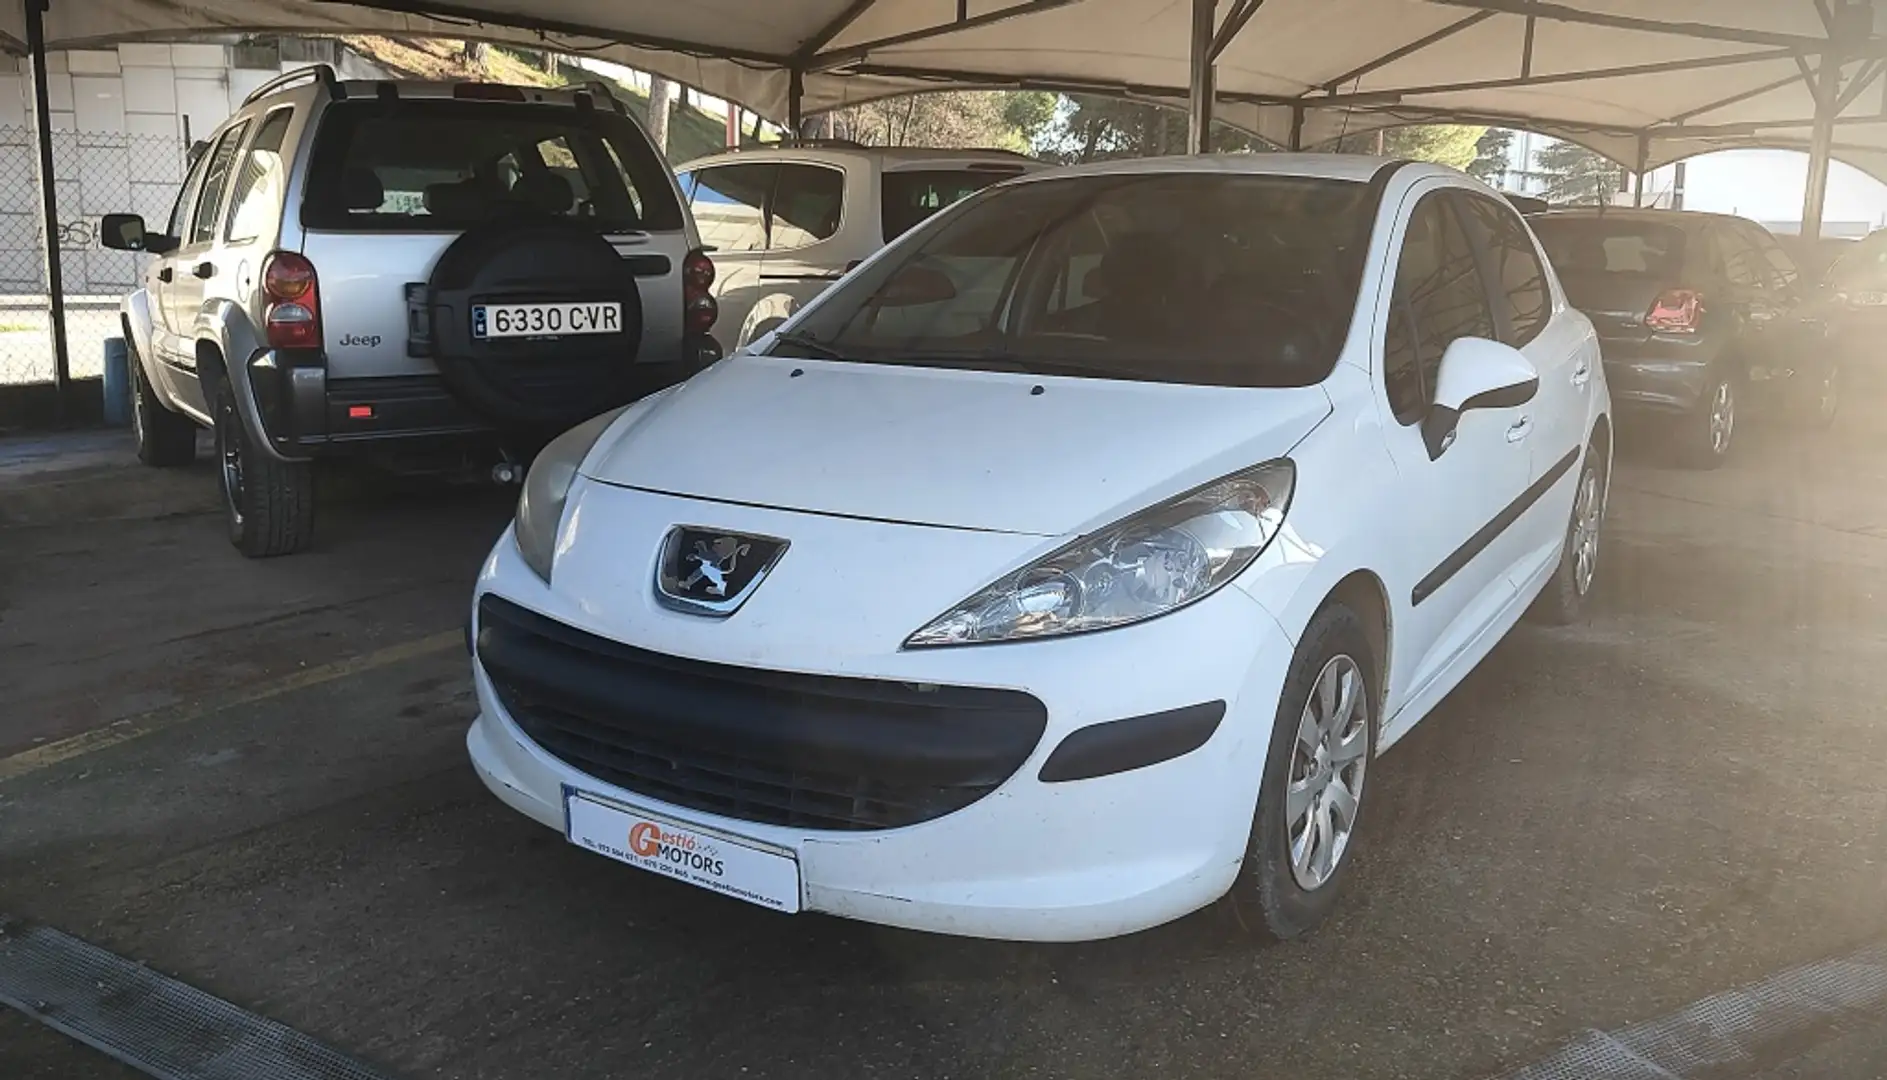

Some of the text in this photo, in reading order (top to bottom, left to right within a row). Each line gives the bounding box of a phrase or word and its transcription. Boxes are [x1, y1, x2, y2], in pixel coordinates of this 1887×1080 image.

[495, 307, 562, 333] 6330
[569, 306, 618, 331] CVR
[339, 333, 381, 348] Jeep
[629, 822, 696, 857] Gestió
[657, 844, 724, 876] MOTORS
